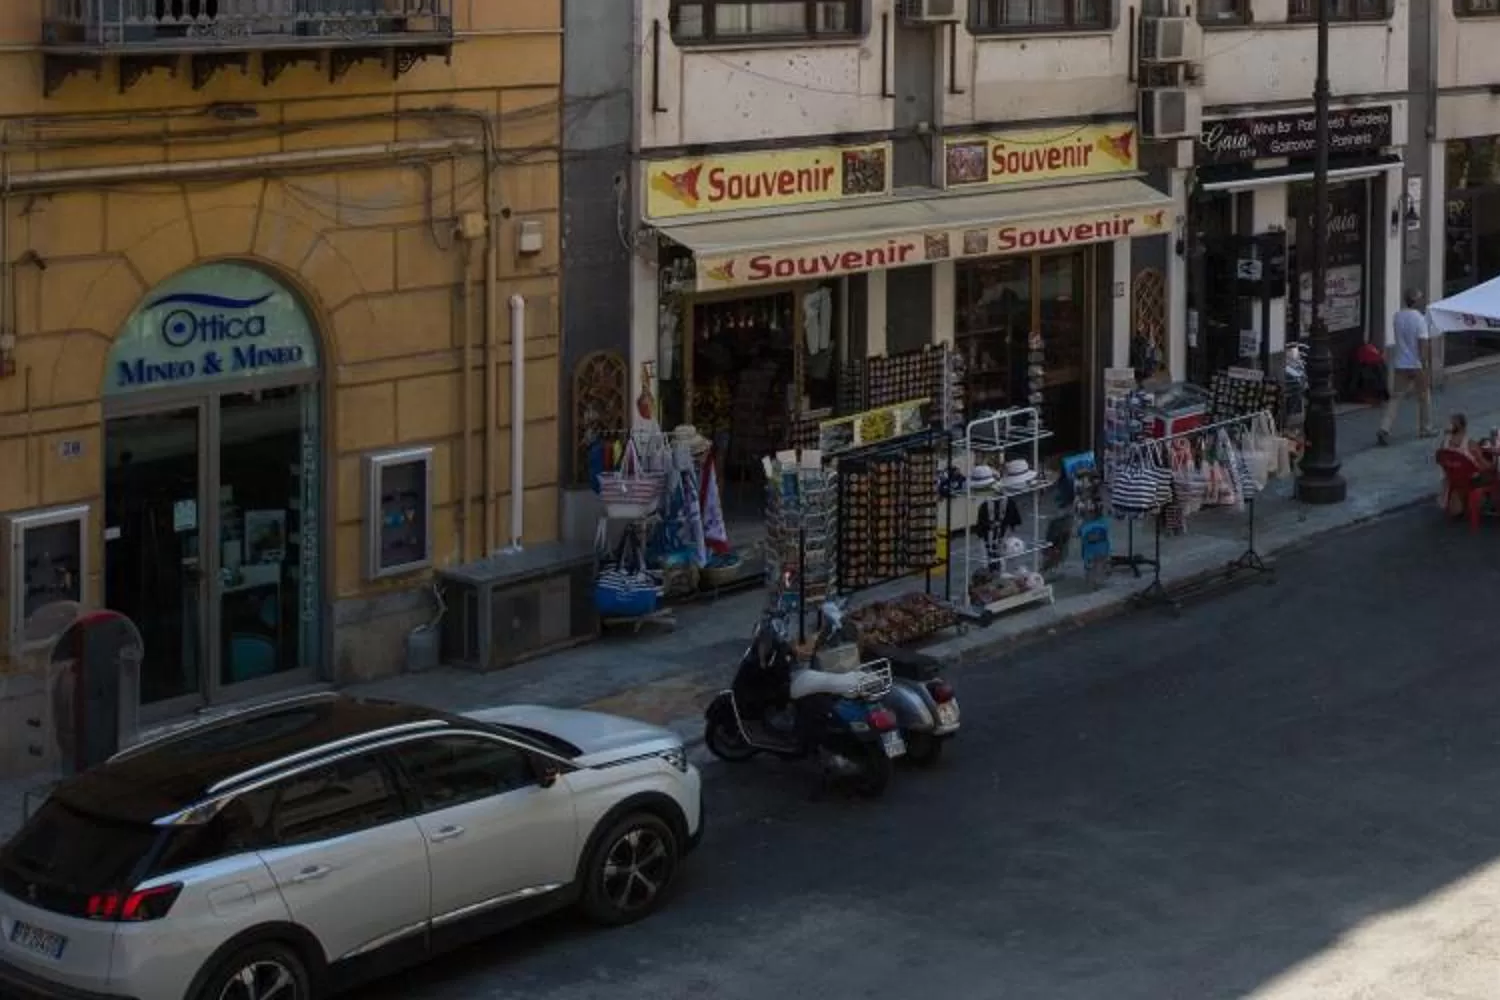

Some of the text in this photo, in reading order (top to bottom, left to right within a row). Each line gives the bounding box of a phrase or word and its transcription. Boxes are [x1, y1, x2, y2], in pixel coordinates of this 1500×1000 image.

[1276, 120, 1292, 133] Bar
[992, 137, 1093, 176] Souvenir
[708, 159, 835, 201] Souvenir
[998, 213, 1135, 250] Souvenir
[748, 240, 915, 281] Souvenir
[163, 309, 266, 347] Ottica
[202, 351, 225, 376] &
